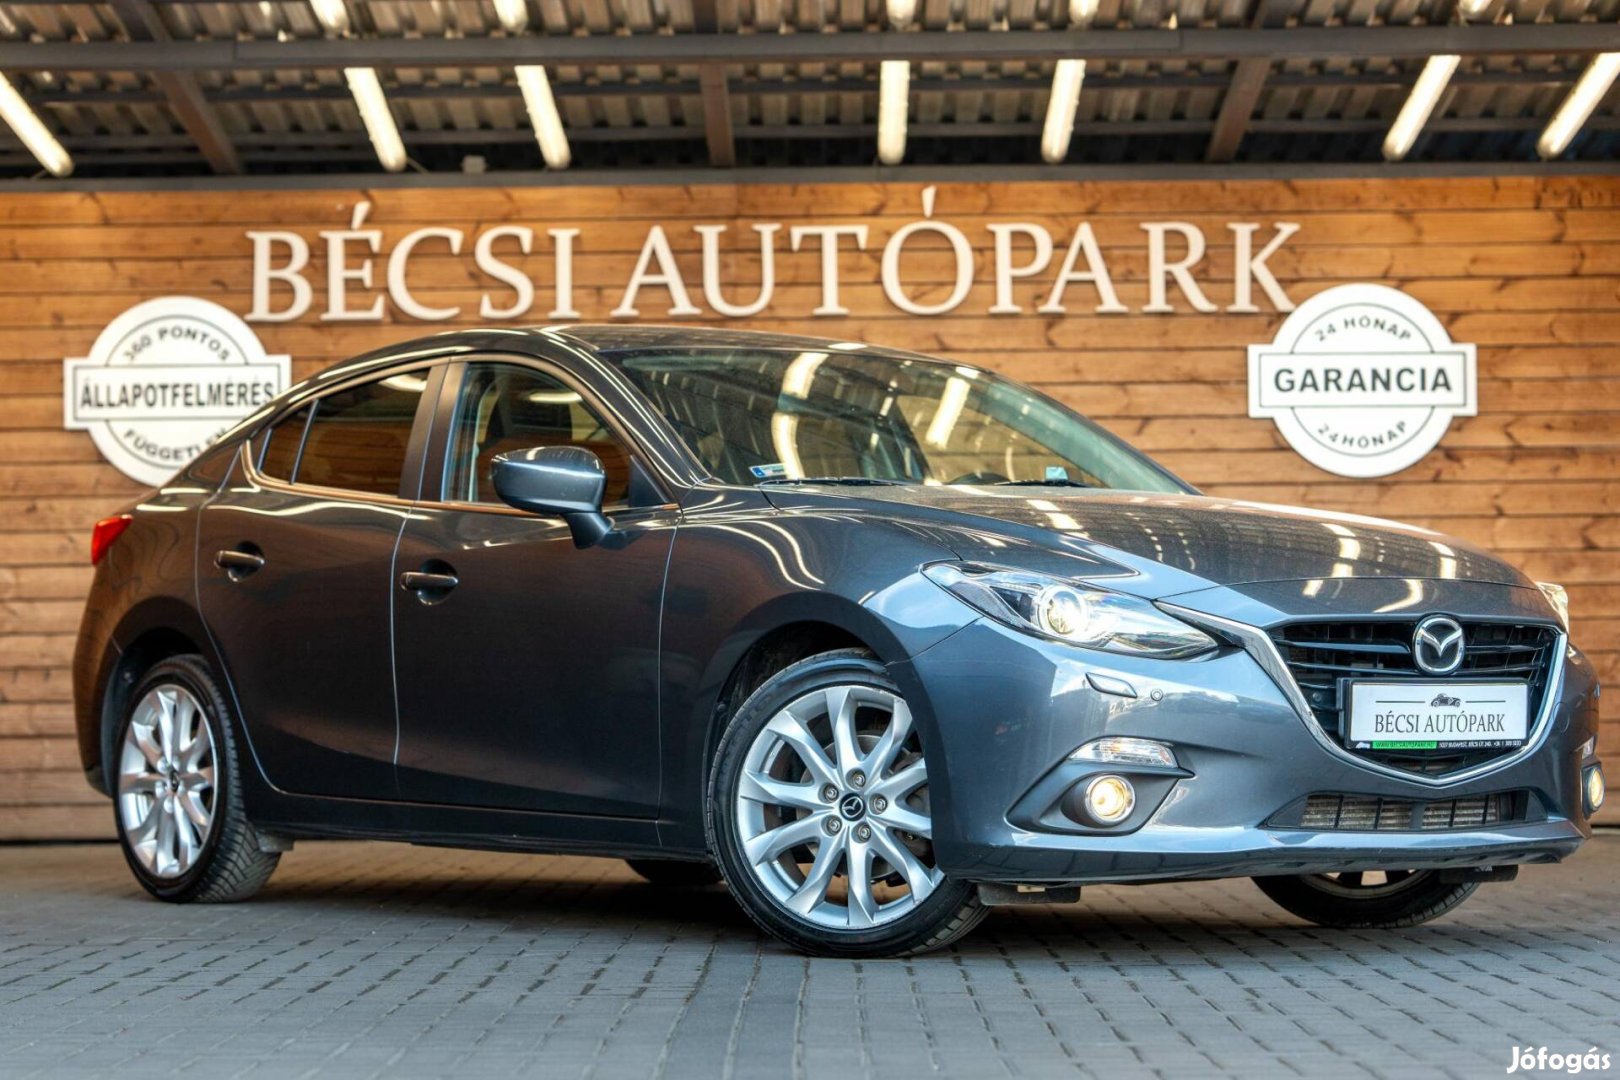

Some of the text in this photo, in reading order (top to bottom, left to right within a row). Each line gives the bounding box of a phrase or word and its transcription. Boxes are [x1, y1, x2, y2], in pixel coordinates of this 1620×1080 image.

[244, 185, 1301, 322] BÉCSI AUTÓPARK
[157, 325, 231, 362] PONTOS
[1315, 323, 1336, 342] 24
[80, 376, 274, 408] ÁLLAPOTFELMÉRÉS
[1274, 367, 1452, 393] GARANCIA
[1374, 710, 1506, 733] BÉCSI AUTÓPARK
